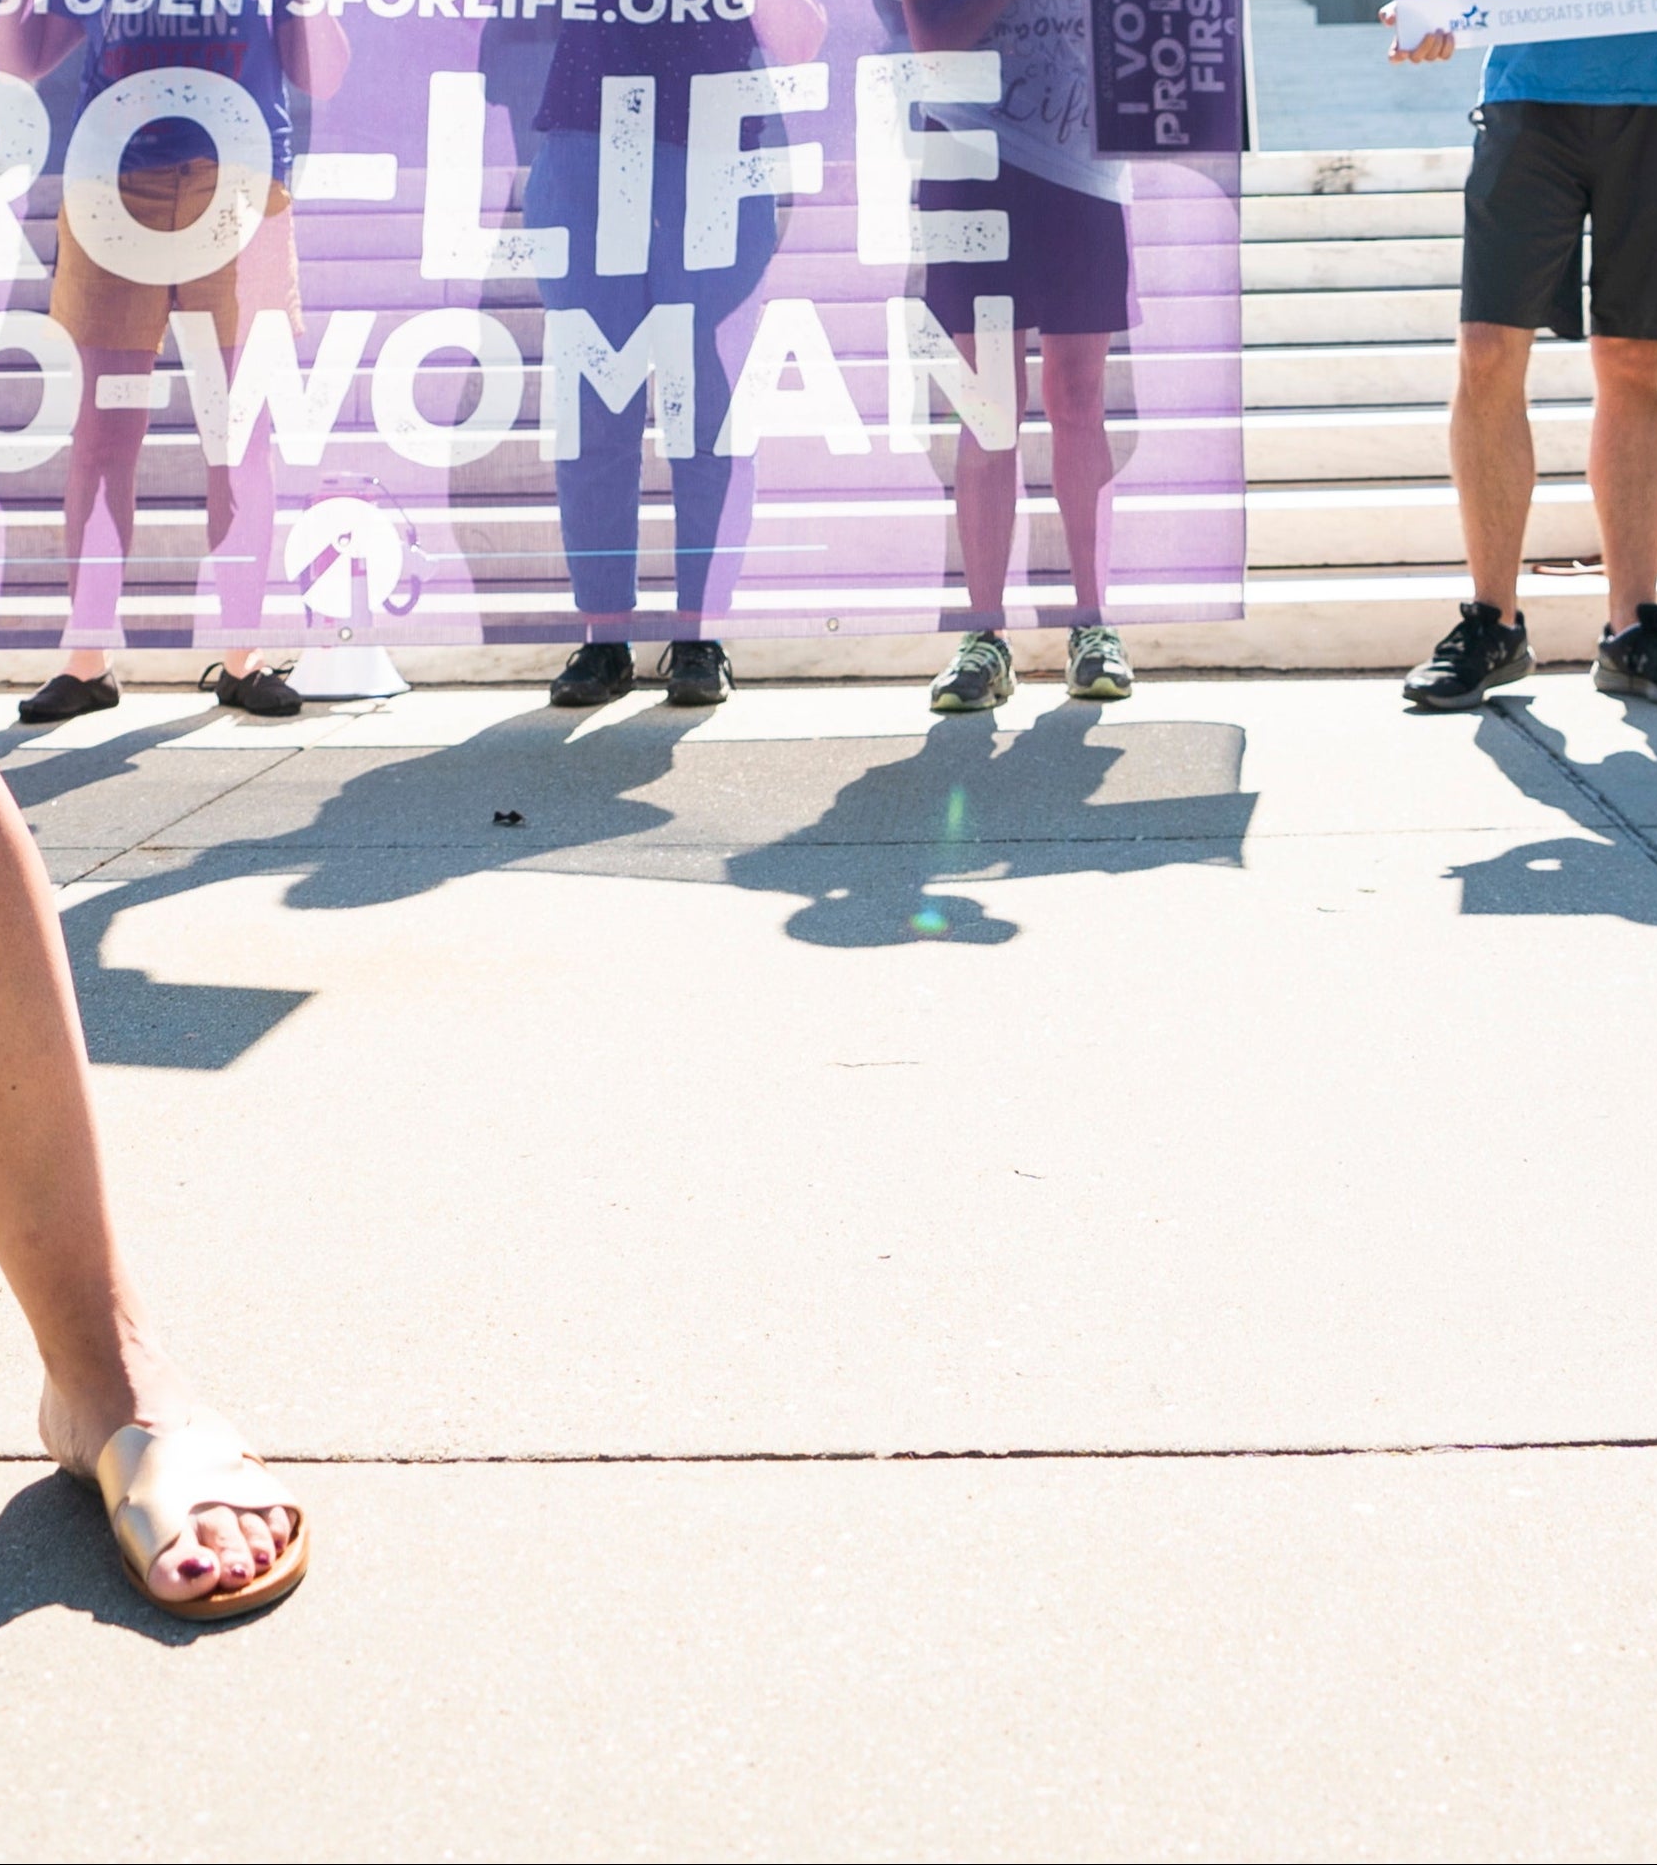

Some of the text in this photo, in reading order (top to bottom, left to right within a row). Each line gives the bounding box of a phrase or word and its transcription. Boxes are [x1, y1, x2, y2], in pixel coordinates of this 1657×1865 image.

[1498, 5, 1584, 27] DEMOCRATS
[1587, 1, 1615, 19] FOR
[1117, 101, 1150, 115] I
